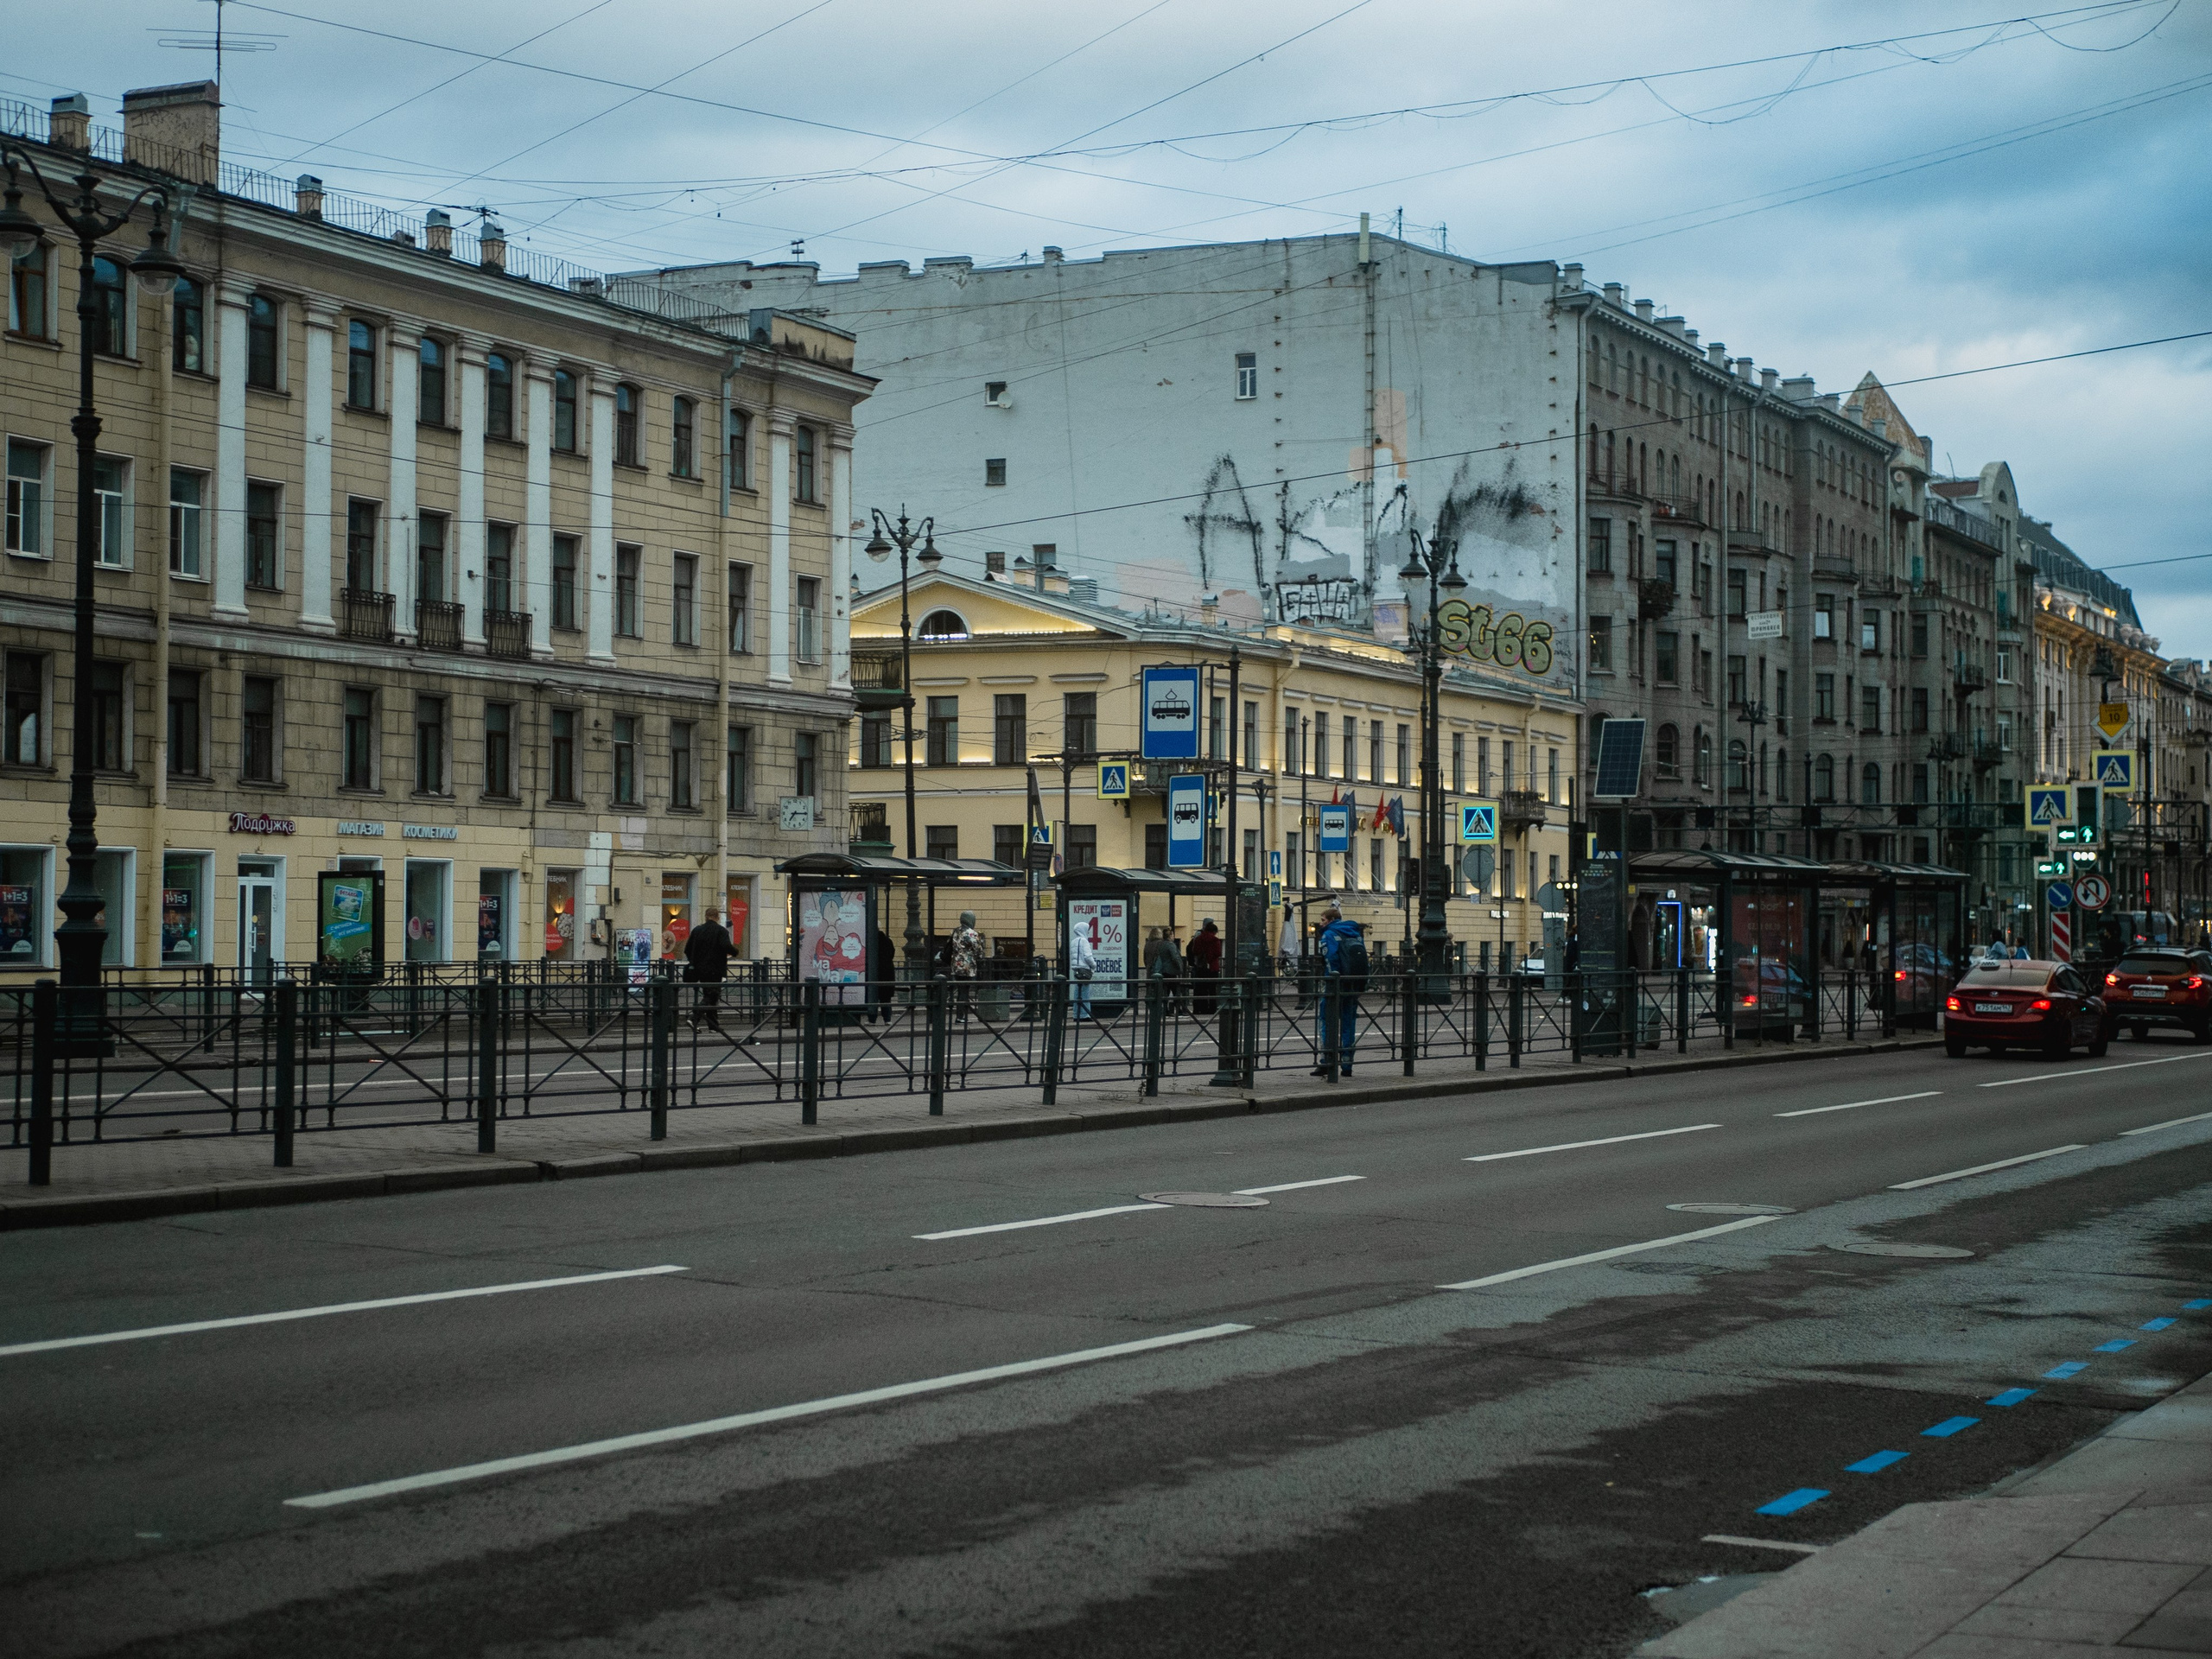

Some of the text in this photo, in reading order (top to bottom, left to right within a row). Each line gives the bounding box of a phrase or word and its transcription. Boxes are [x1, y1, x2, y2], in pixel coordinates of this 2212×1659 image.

[2109, 713, 2120, 722] 10
[231, 812, 296, 835] Подружка
[338, 822, 458, 839] МАГАЗИН КОСМЕТИКИ
[2, 891, 28, 901] 1+1=3
[165, 893, 188, 904] 1+1=3
[1073, 905, 1098, 915] КРЕДИТ
[1094, 958, 1122, 973] ВСЁВСЁ
